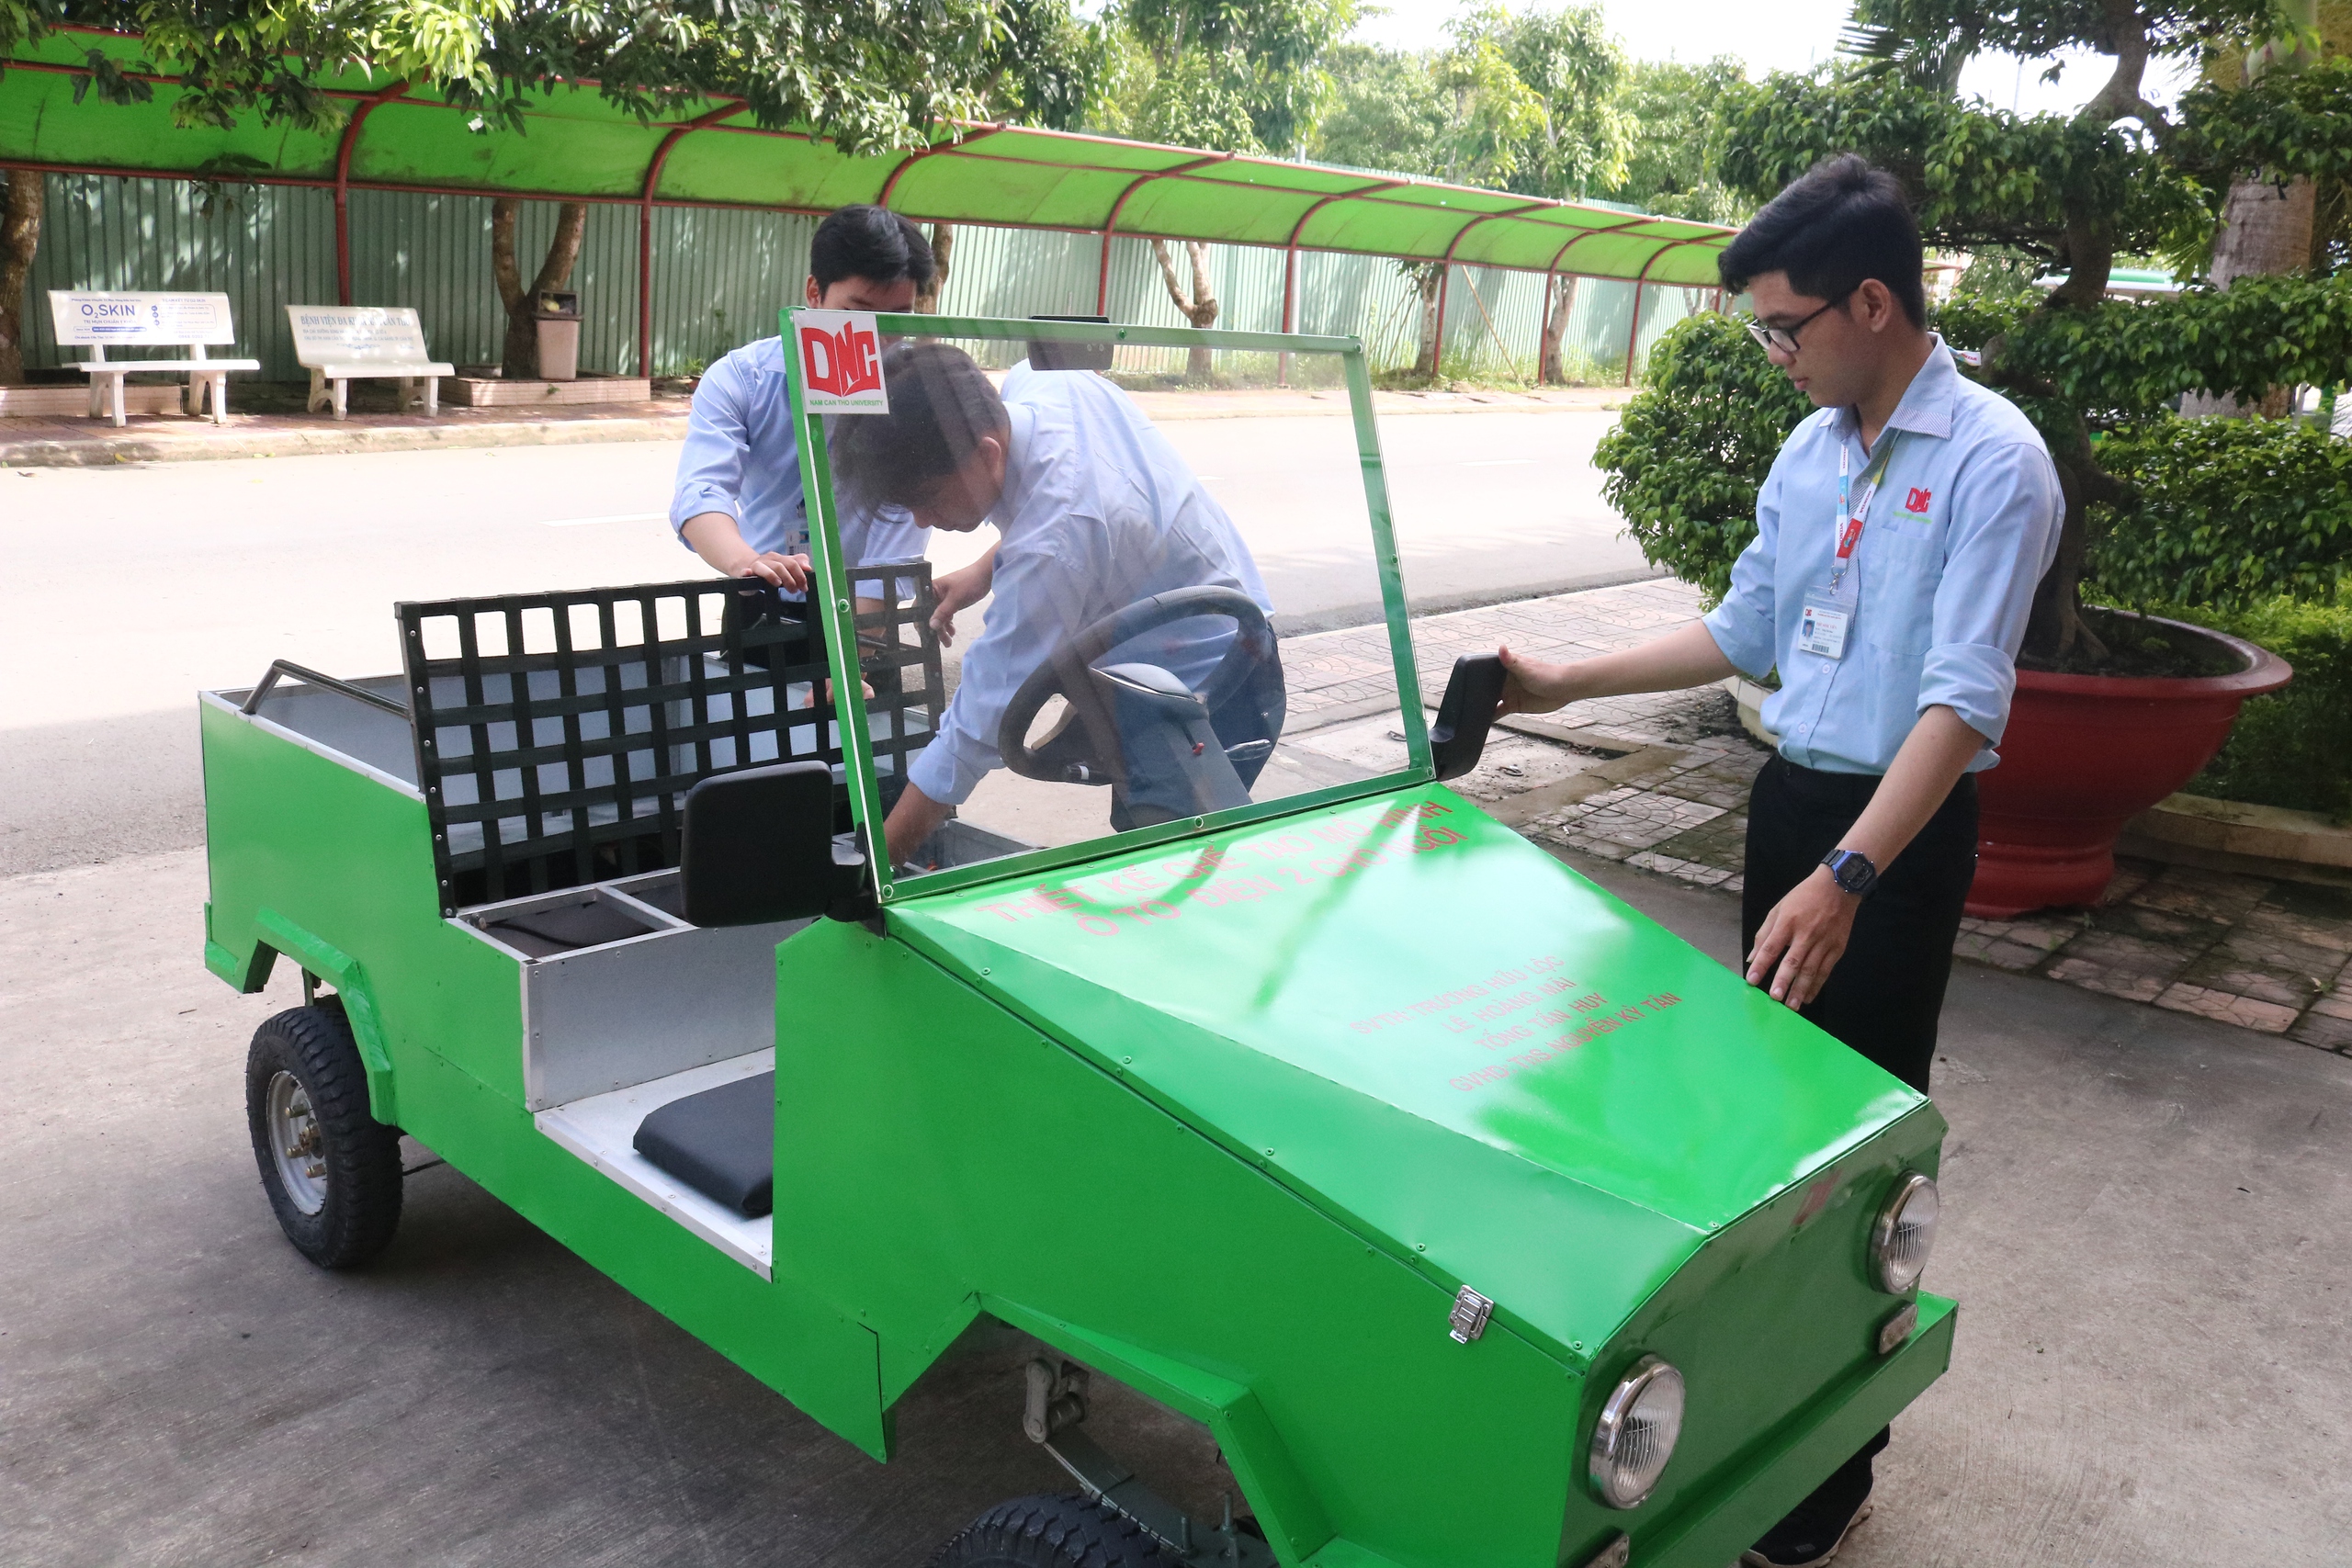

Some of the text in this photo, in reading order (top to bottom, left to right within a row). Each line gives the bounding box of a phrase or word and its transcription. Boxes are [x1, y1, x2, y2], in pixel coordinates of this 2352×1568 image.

[300, 313, 320, 327] BỆNH
[320, 313, 336, 328] VIỆN
[800, 321, 881, 398] DNC
[974, 800, 1453, 922] THIẾT KẾ CHẾ TẠO MÔ HÌNH
[1072, 824, 1469, 937] Ô TÔ ĐIỆN 2 CHỖ NGỒI
[1523, 955, 1566, 975] LỘC
[1442, 1014, 1476, 1033] LÊ
[1471, 990, 1544, 1022] HOÀNG
[1567, 992, 1609, 1013] HUY
[1640, 991, 1683, 1011] TÂN
